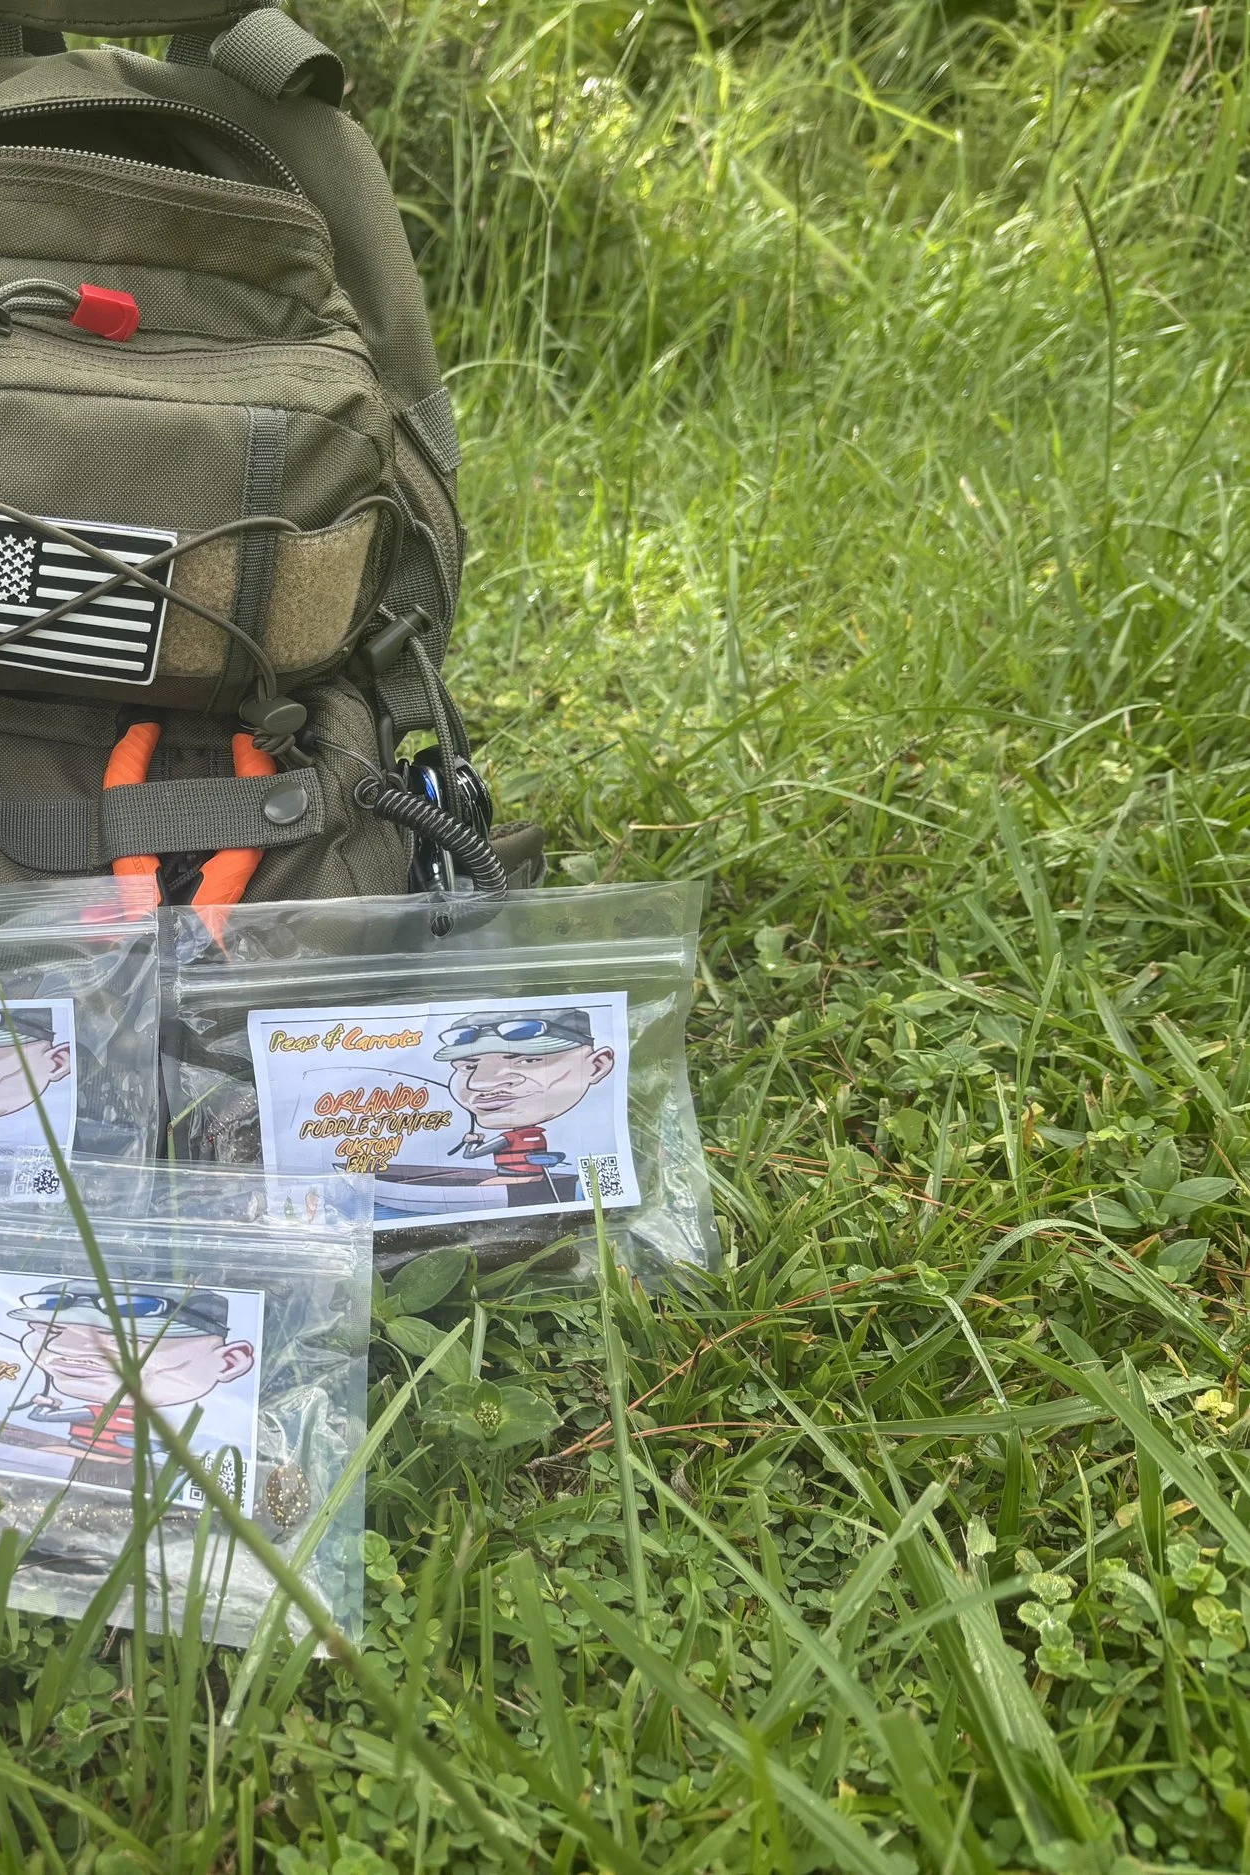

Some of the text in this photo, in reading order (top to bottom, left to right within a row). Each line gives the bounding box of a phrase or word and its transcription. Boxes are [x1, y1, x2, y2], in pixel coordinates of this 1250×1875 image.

[269, 1023, 423, 1053] Peas & Carrots
[314, 1082, 429, 1116] ORLANDO
[300, 1111, 452, 1139] PUDDLE JUMPER
[336, 1135, 403, 1157] CUSTOM
[346, 1154, 392, 1174] BAITS
